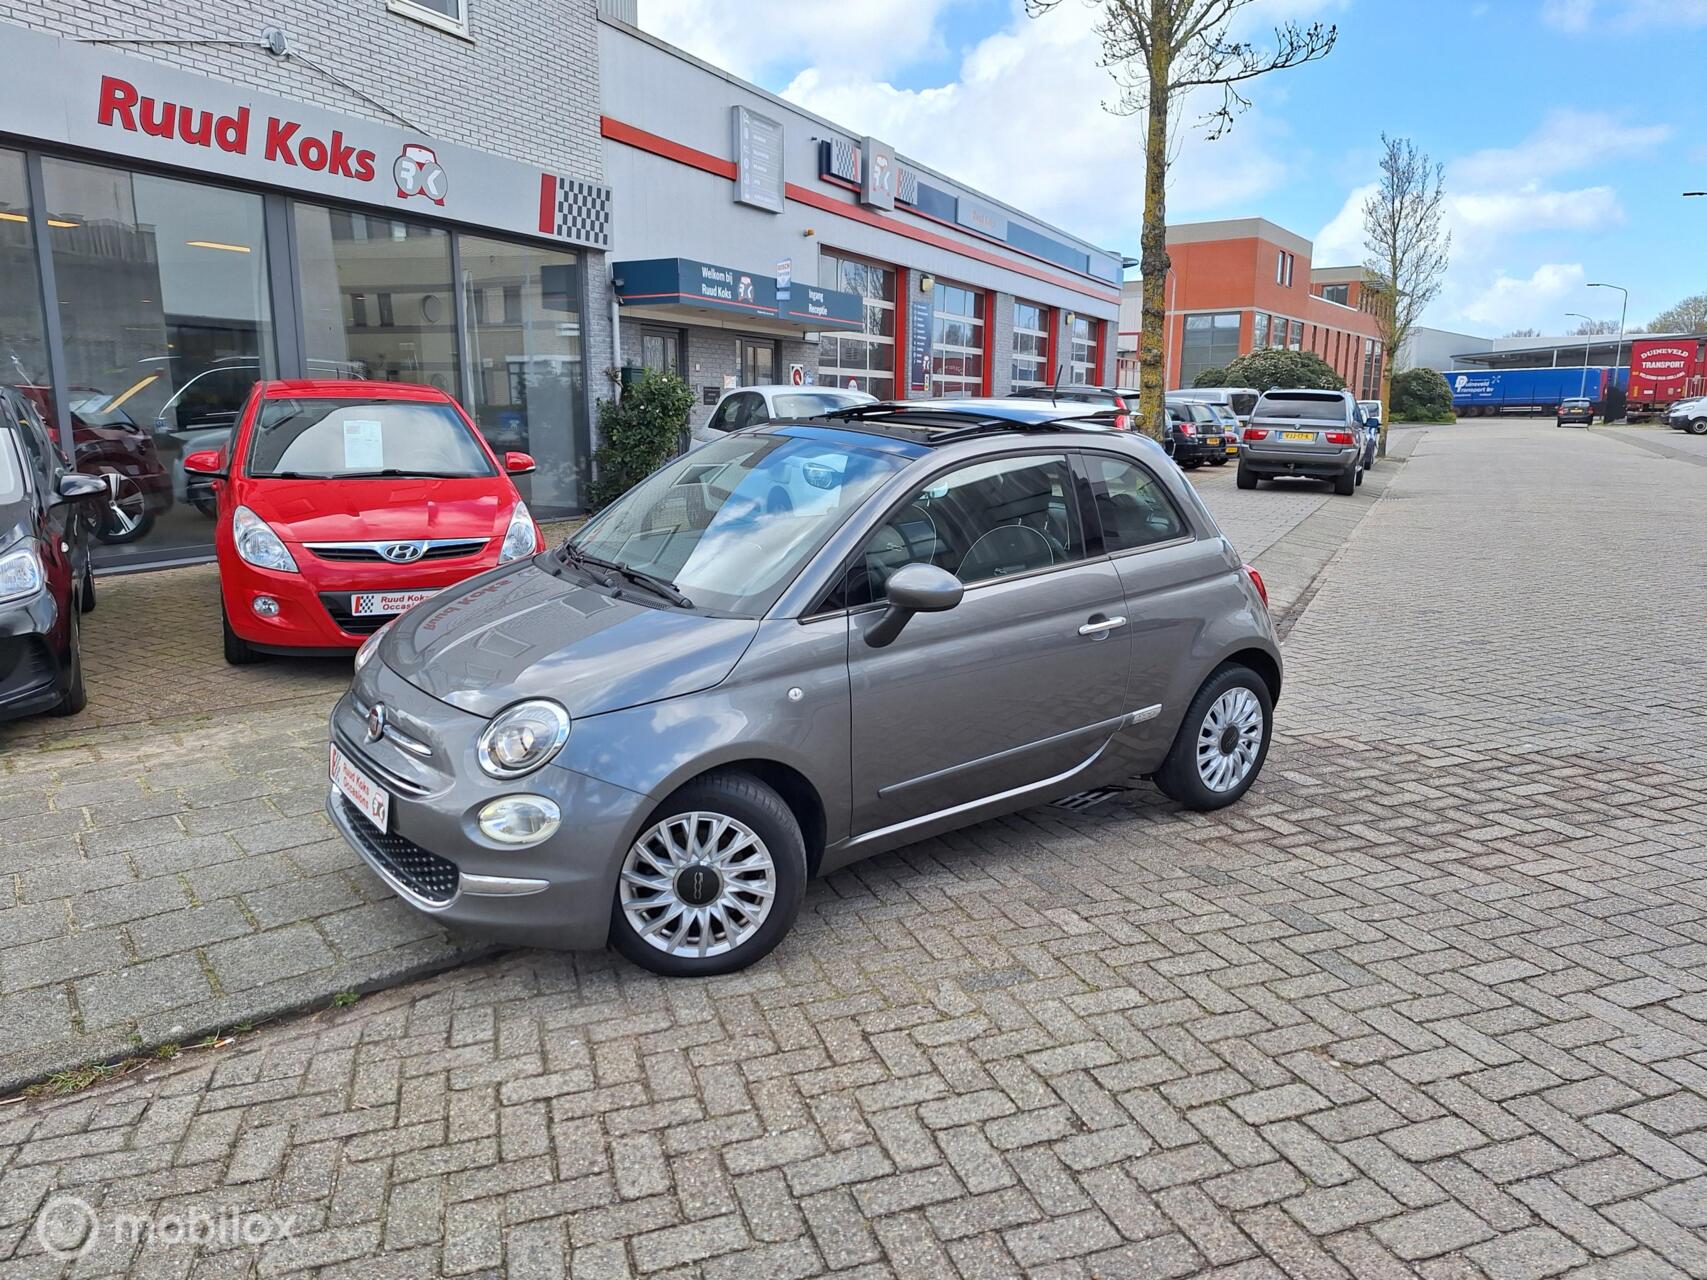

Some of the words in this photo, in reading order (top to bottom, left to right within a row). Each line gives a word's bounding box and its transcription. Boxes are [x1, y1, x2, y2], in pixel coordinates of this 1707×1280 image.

[98, 75, 251, 155] Ruud
[264, 116, 376, 182] Koks
[701, 267, 726, 282] Welkom
[701, 284, 717, 297] Ruud
[717, 287, 732, 299] Koks
[808, 289, 823, 302] Ingang
[808, 303, 828, 316] Receptie
[1640, 348, 1689, 359] DUINEVELD
[1642, 361, 1685, 369] TRANSPORT
[380, 595, 405, 603] Ruud
[382, 602, 415, 610] Occas
[342, 762, 357, 782] Ruud
[356, 776, 370, 796] Koks
[342, 777, 369, 810] Occasions
